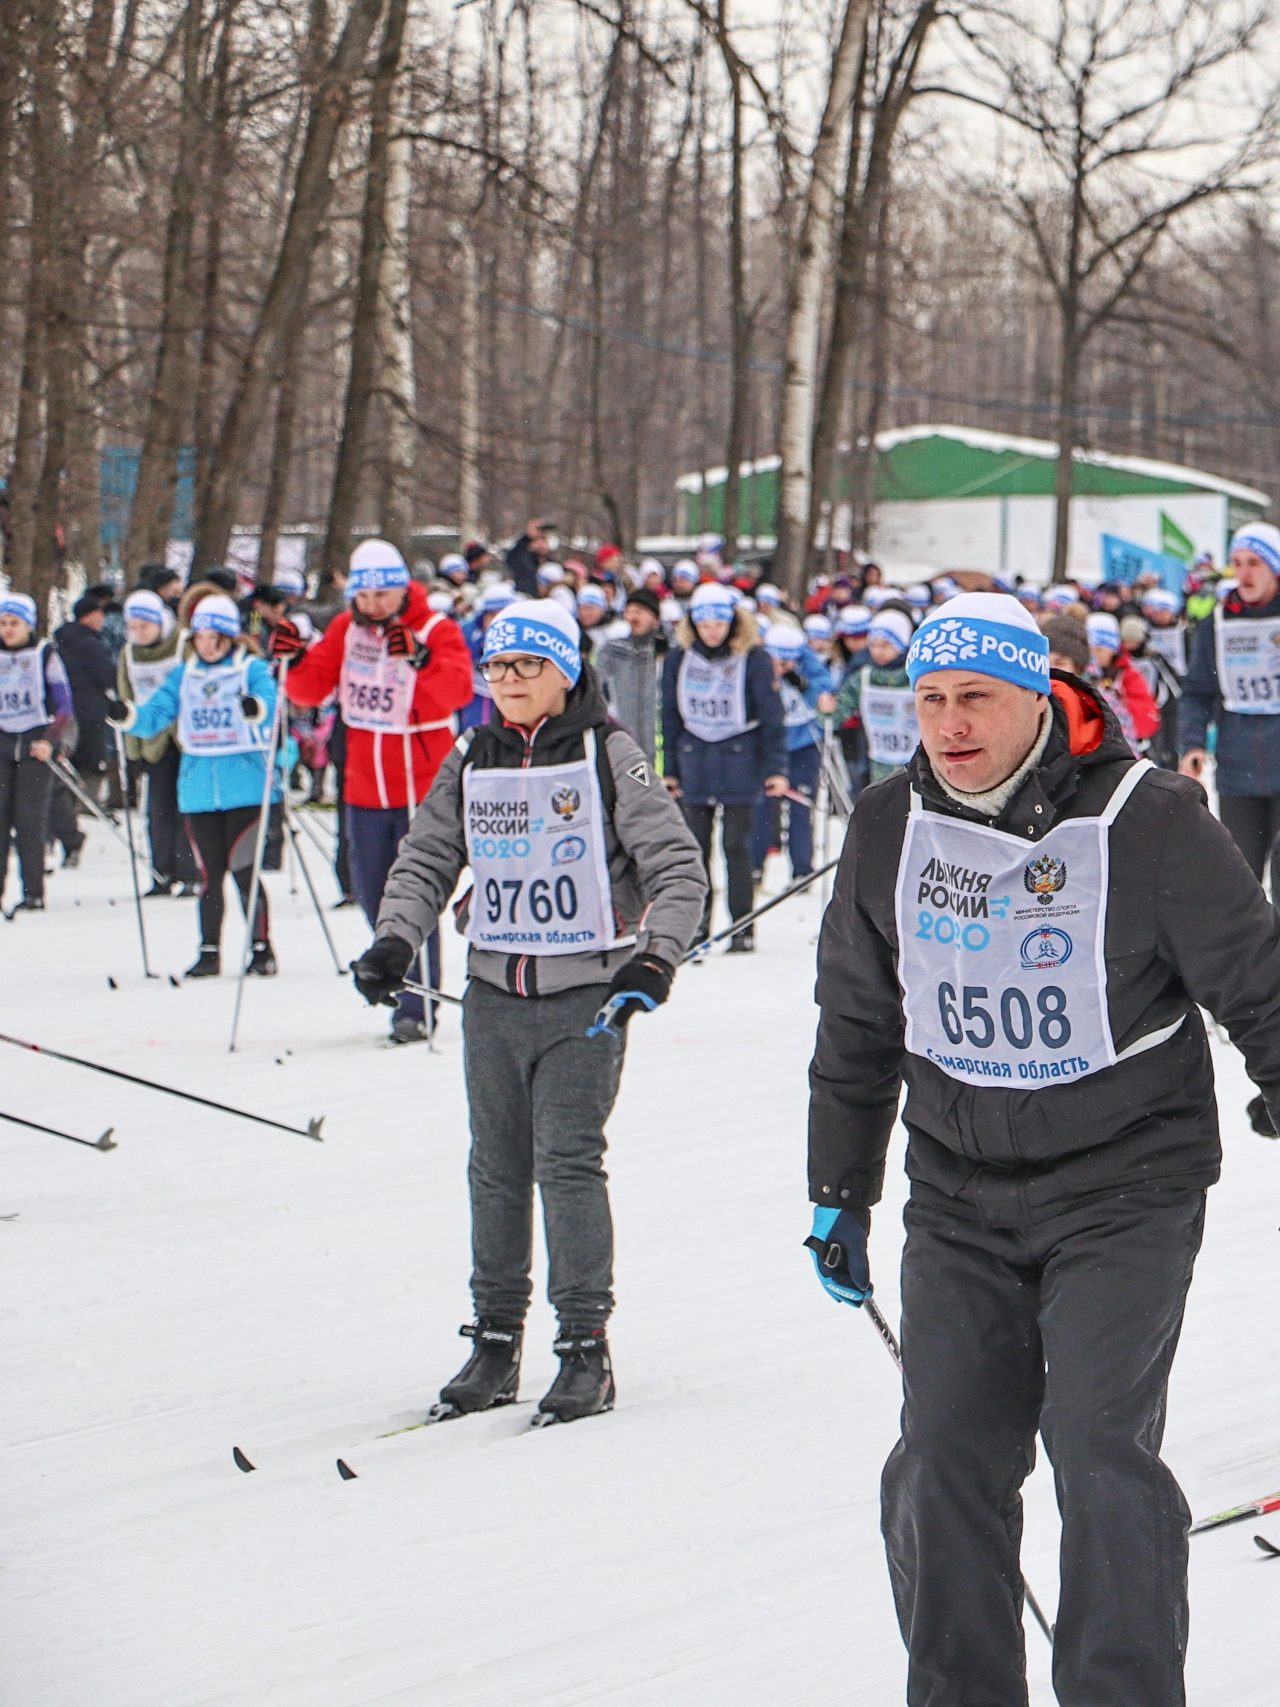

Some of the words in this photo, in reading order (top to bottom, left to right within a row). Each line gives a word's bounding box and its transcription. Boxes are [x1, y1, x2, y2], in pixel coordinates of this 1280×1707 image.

[469, 801, 529, 818] ЛЫЖНЯ
[470, 818, 529, 835] РОССИИ
[472, 838, 531, 859] 2020
[920, 857, 993, 893] ЛЫЖНЯ
[485, 875, 578, 924] 9760
[480, 932, 541, 944] Самарская
[546, 930, 595, 943] область
[937, 981, 1071, 1049] 6508
[926, 1048, 1012, 1079] Самарская
[1018, 1056, 1090, 1080] область
